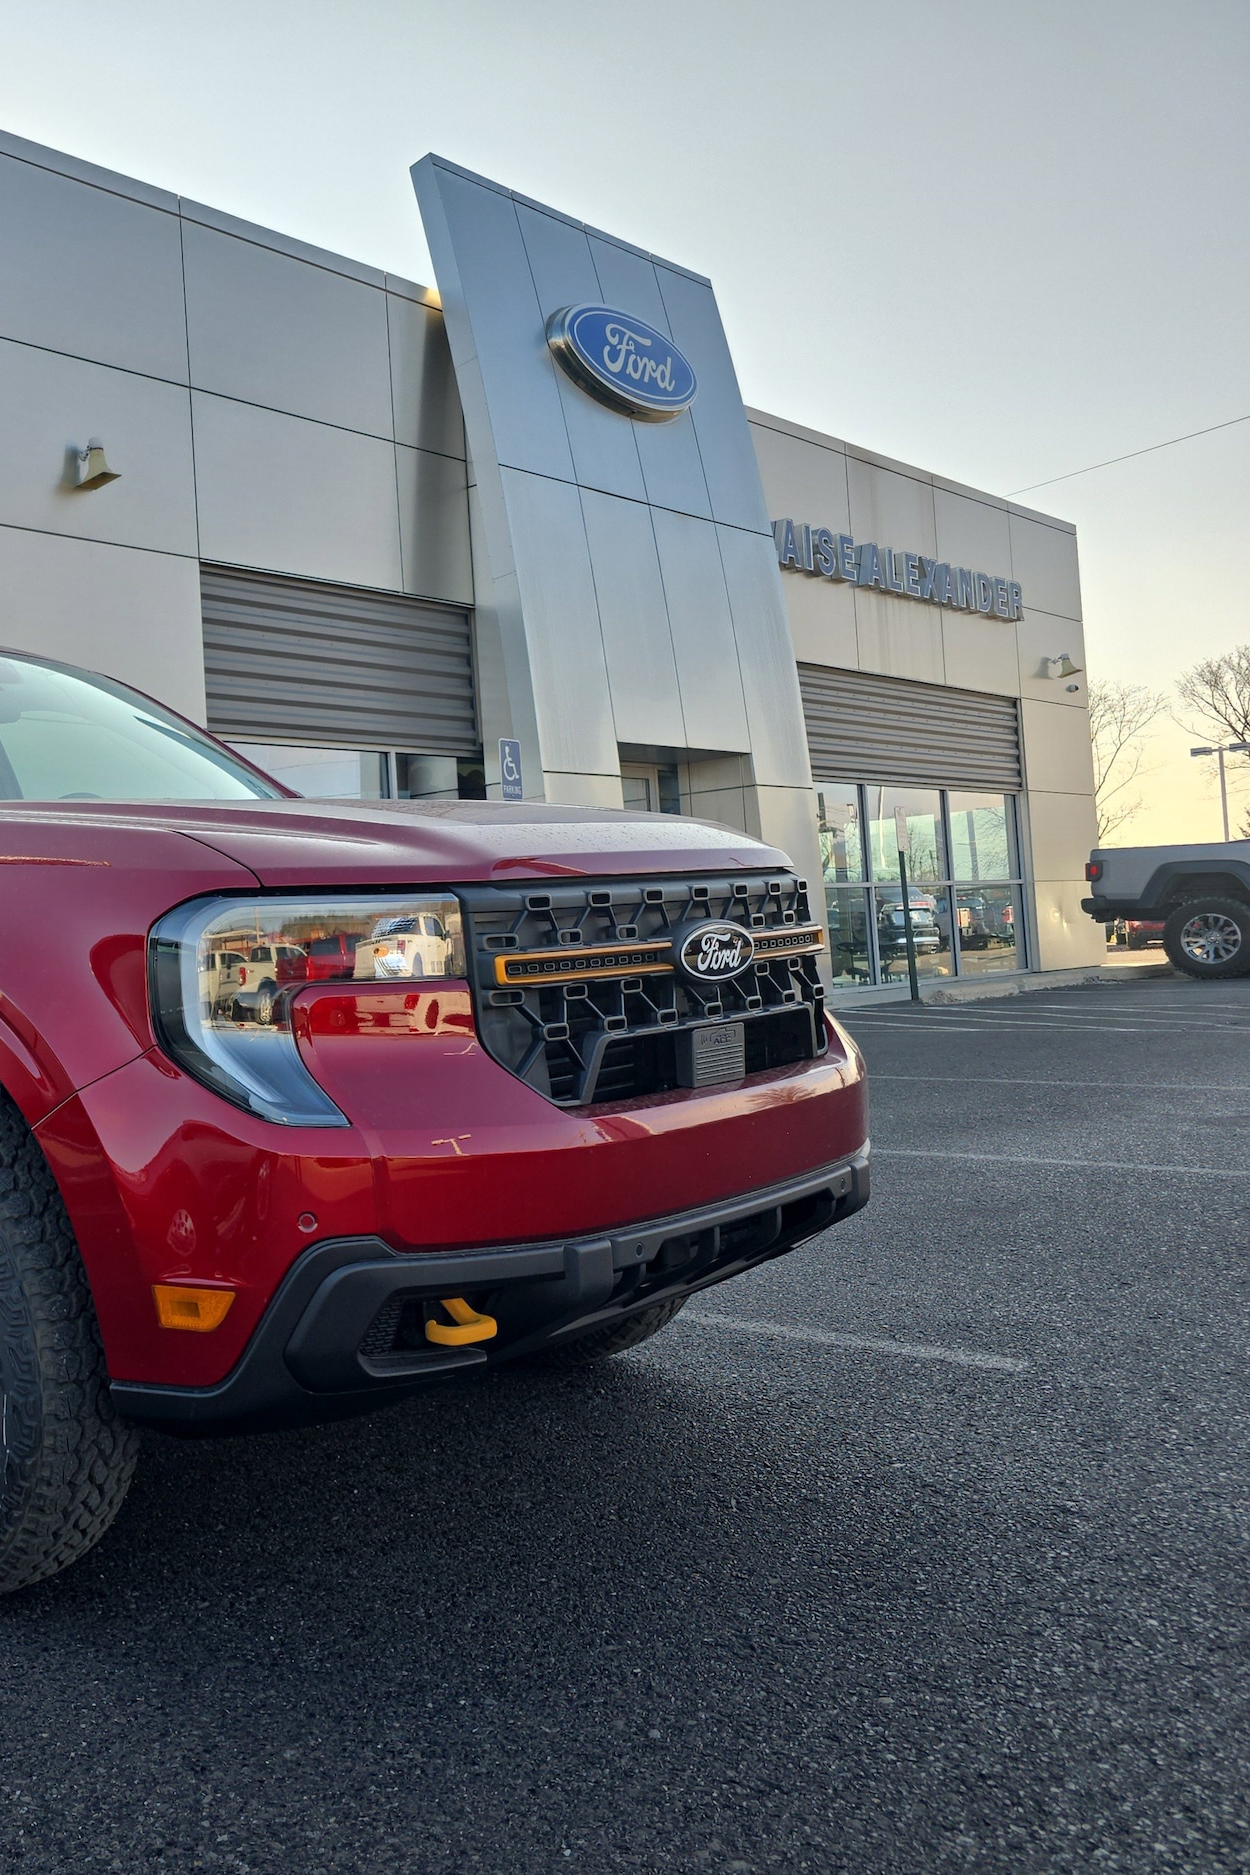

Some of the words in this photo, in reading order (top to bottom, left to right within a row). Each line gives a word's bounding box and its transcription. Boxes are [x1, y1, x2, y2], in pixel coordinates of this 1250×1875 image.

[603, 323, 676, 392] Ford
[858, 543, 1025, 621] ALEXANDER
[697, 933, 741, 971] Ford
